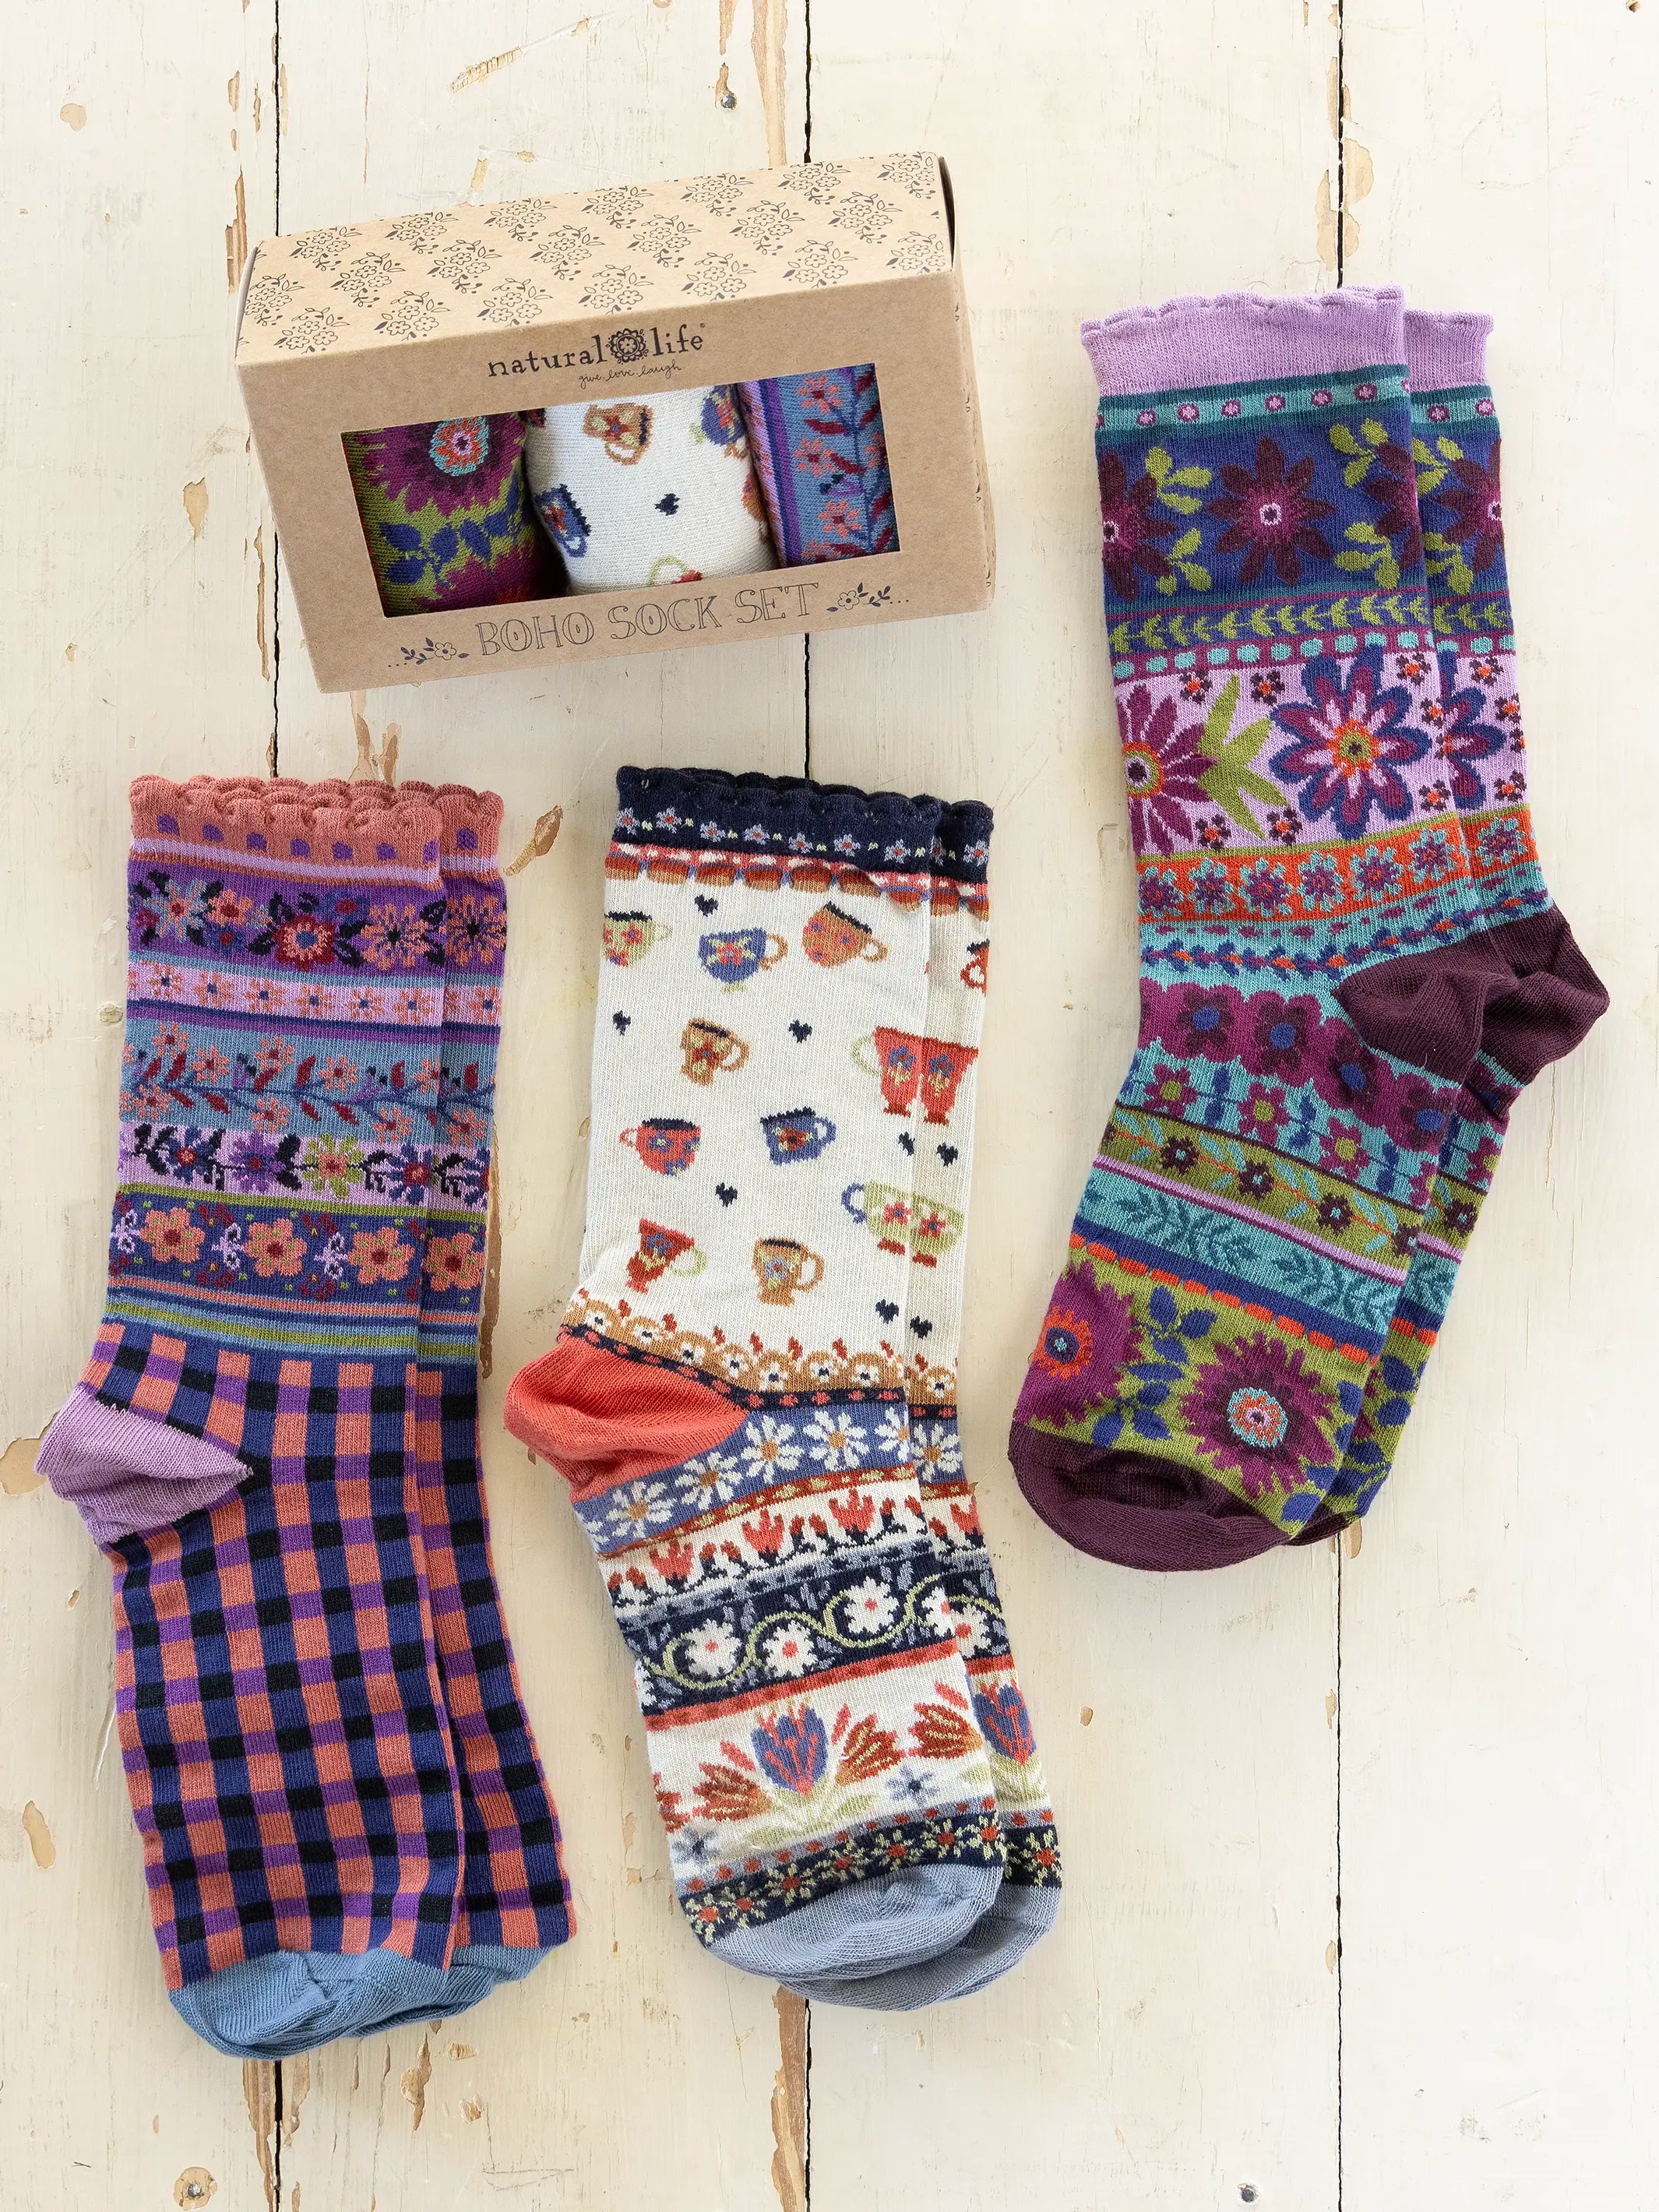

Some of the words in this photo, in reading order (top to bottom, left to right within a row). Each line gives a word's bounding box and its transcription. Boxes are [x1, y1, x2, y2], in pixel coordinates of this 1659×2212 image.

[488, 335, 608, 377] natural
[474, 612, 595, 657] BOHO
[608, 595, 722, 640] SOCK
[734, 583, 819, 624] SET
